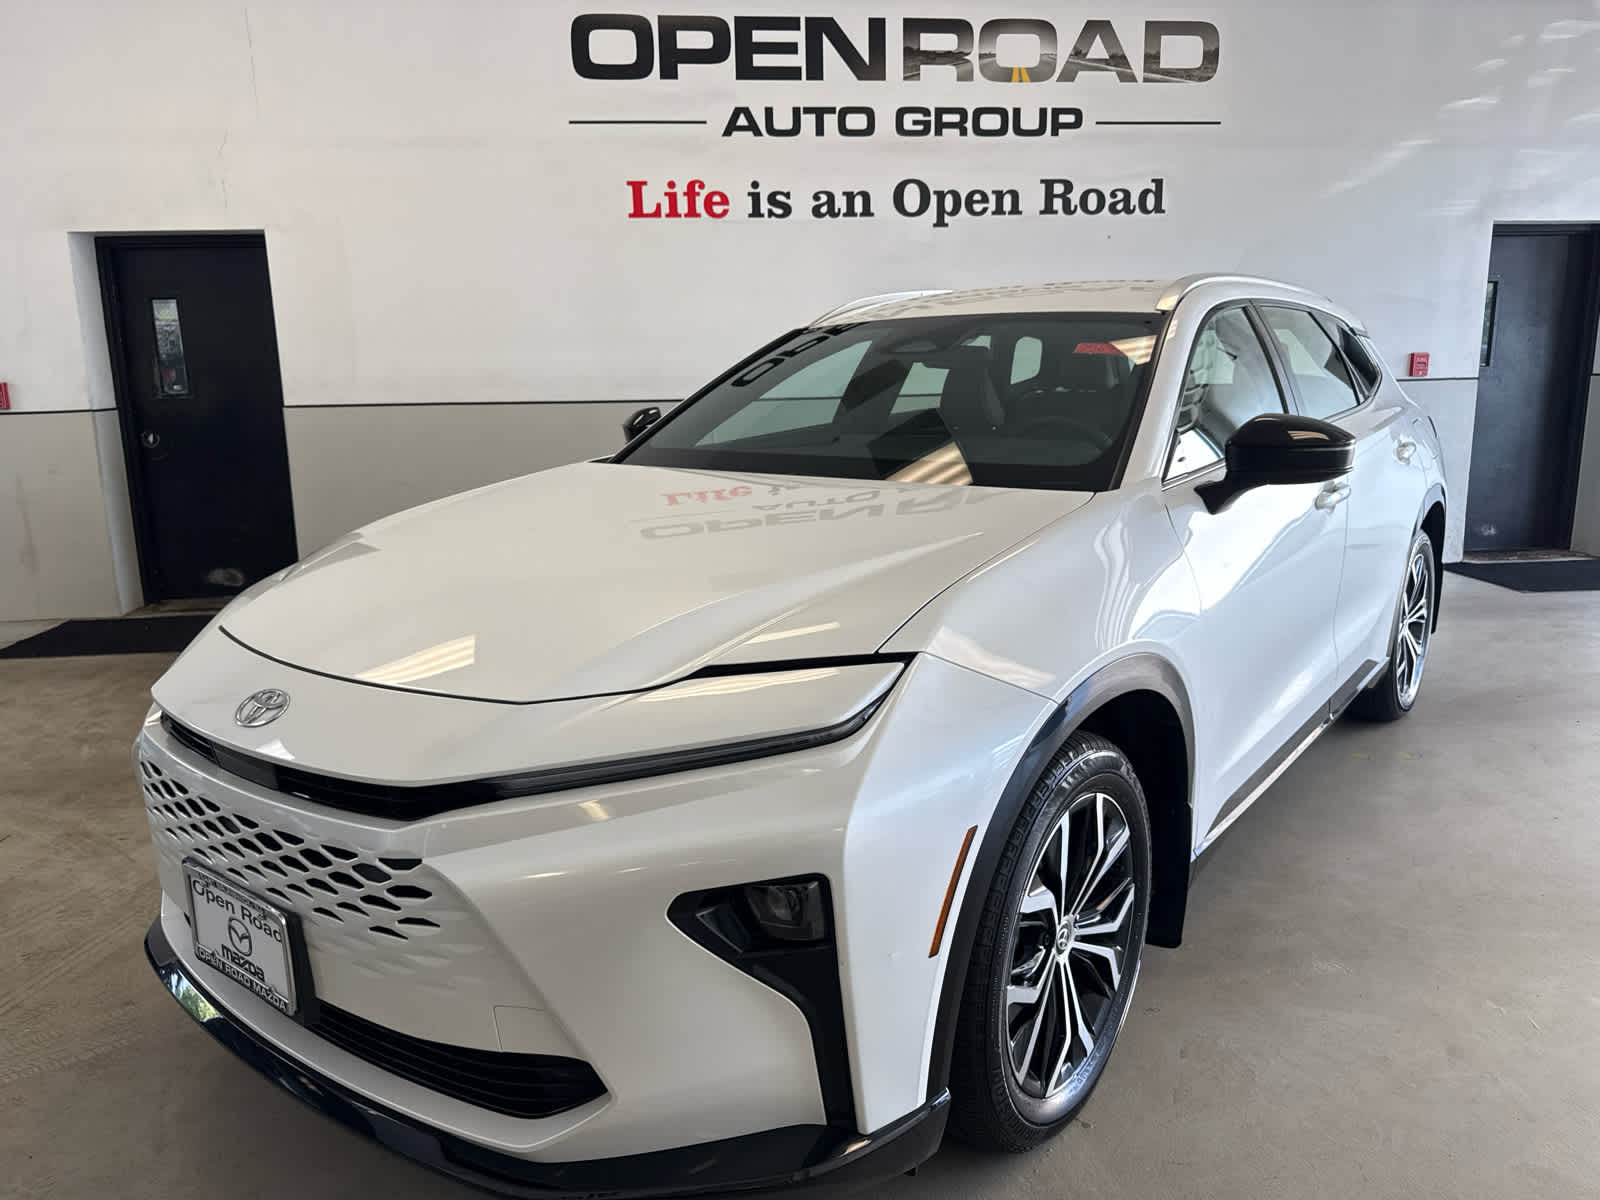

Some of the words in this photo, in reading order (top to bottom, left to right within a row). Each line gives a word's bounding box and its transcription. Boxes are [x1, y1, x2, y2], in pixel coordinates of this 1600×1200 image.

[570, 13, 887, 82] OPEN
[902, 17, 1221, 84] ROAD
[722, 106, 876, 138] AUTO
[895, 106, 1084, 138] GROUP
[626, 179, 730, 219] Life
[747, 180, 793, 218] is
[811, 190, 875, 218] an
[892, 178, 1023, 228] Open
[1038, 178, 1166, 216] Road
[192, 879, 236, 914] Open
[225, 963, 250, 986] ROAD
[253, 981, 287, 1012] MAZDA
